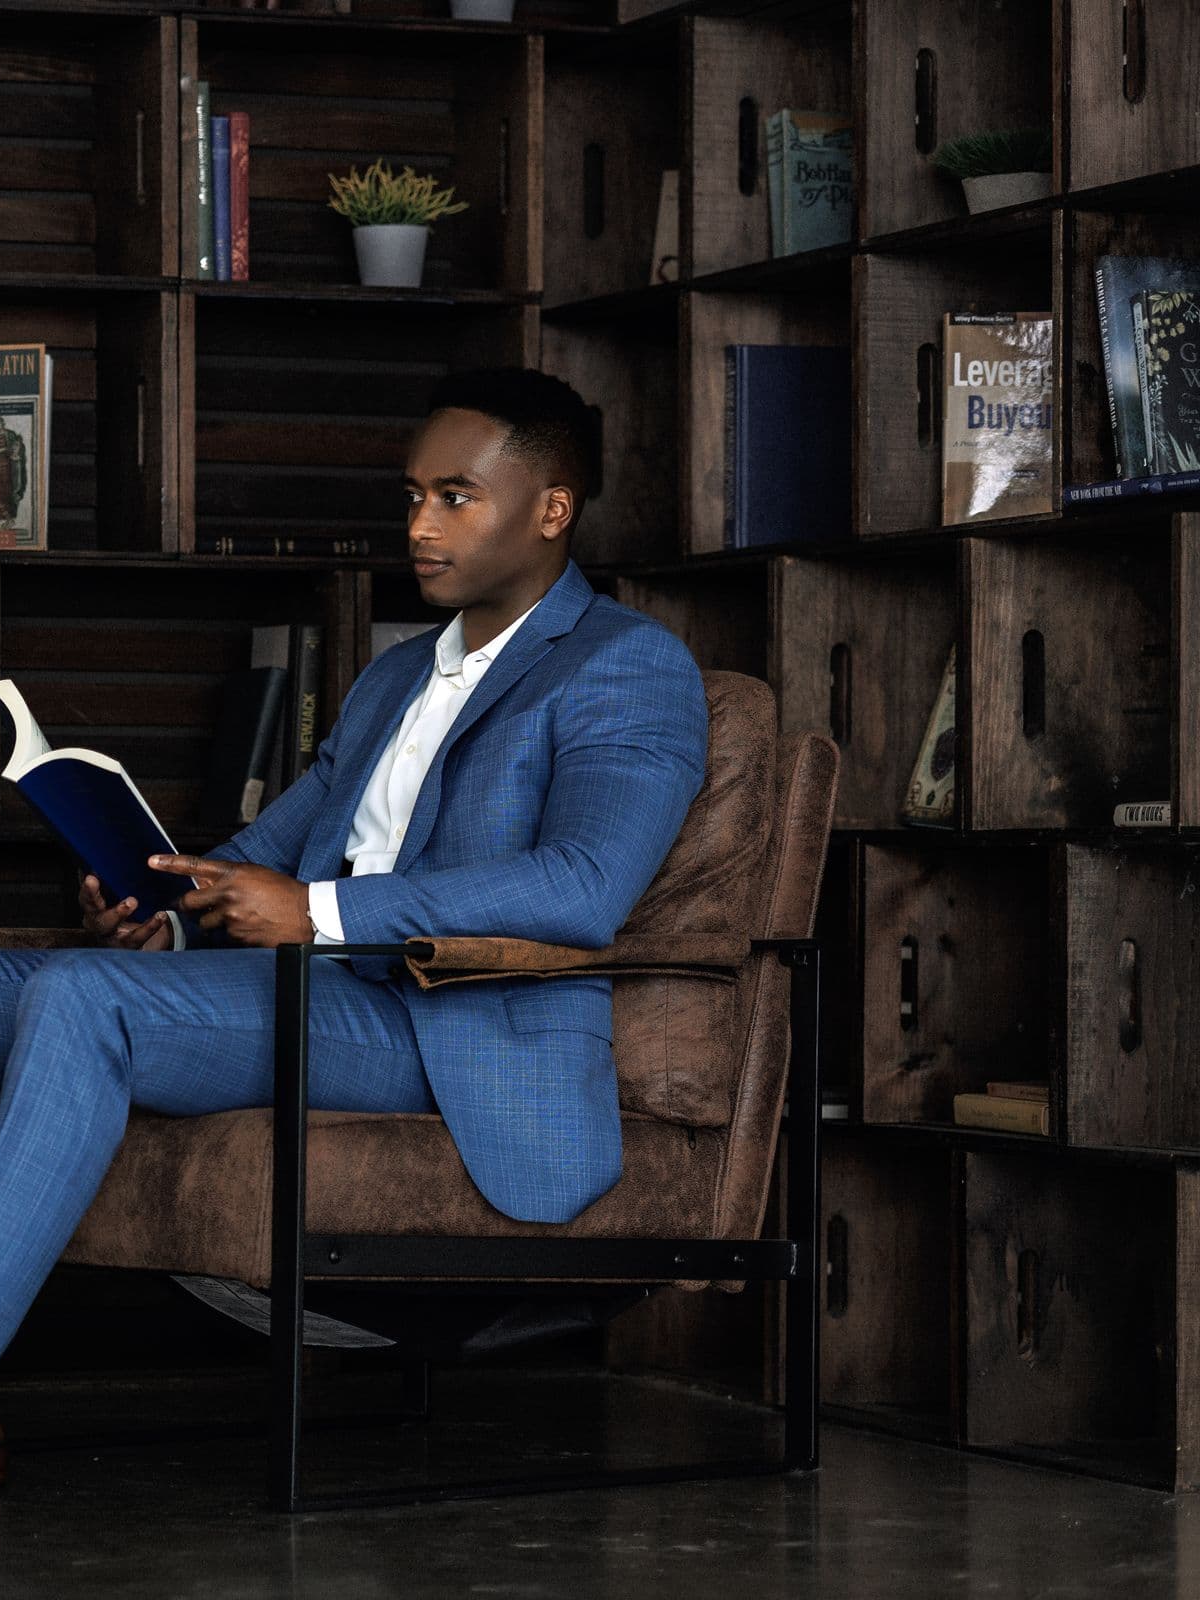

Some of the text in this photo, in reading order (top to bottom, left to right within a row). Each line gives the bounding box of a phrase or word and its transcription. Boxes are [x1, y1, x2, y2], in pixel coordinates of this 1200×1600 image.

[1095, 269, 1106, 314] RUNNING
[1100, 316, 1108, 326] IS
[1102, 337, 1111, 360] KIND
[1106, 377, 1117, 429] DREAMING
[299, 692, 316, 752] NEWJACK
[1125, 805, 1163, 822] TWO HOURS
